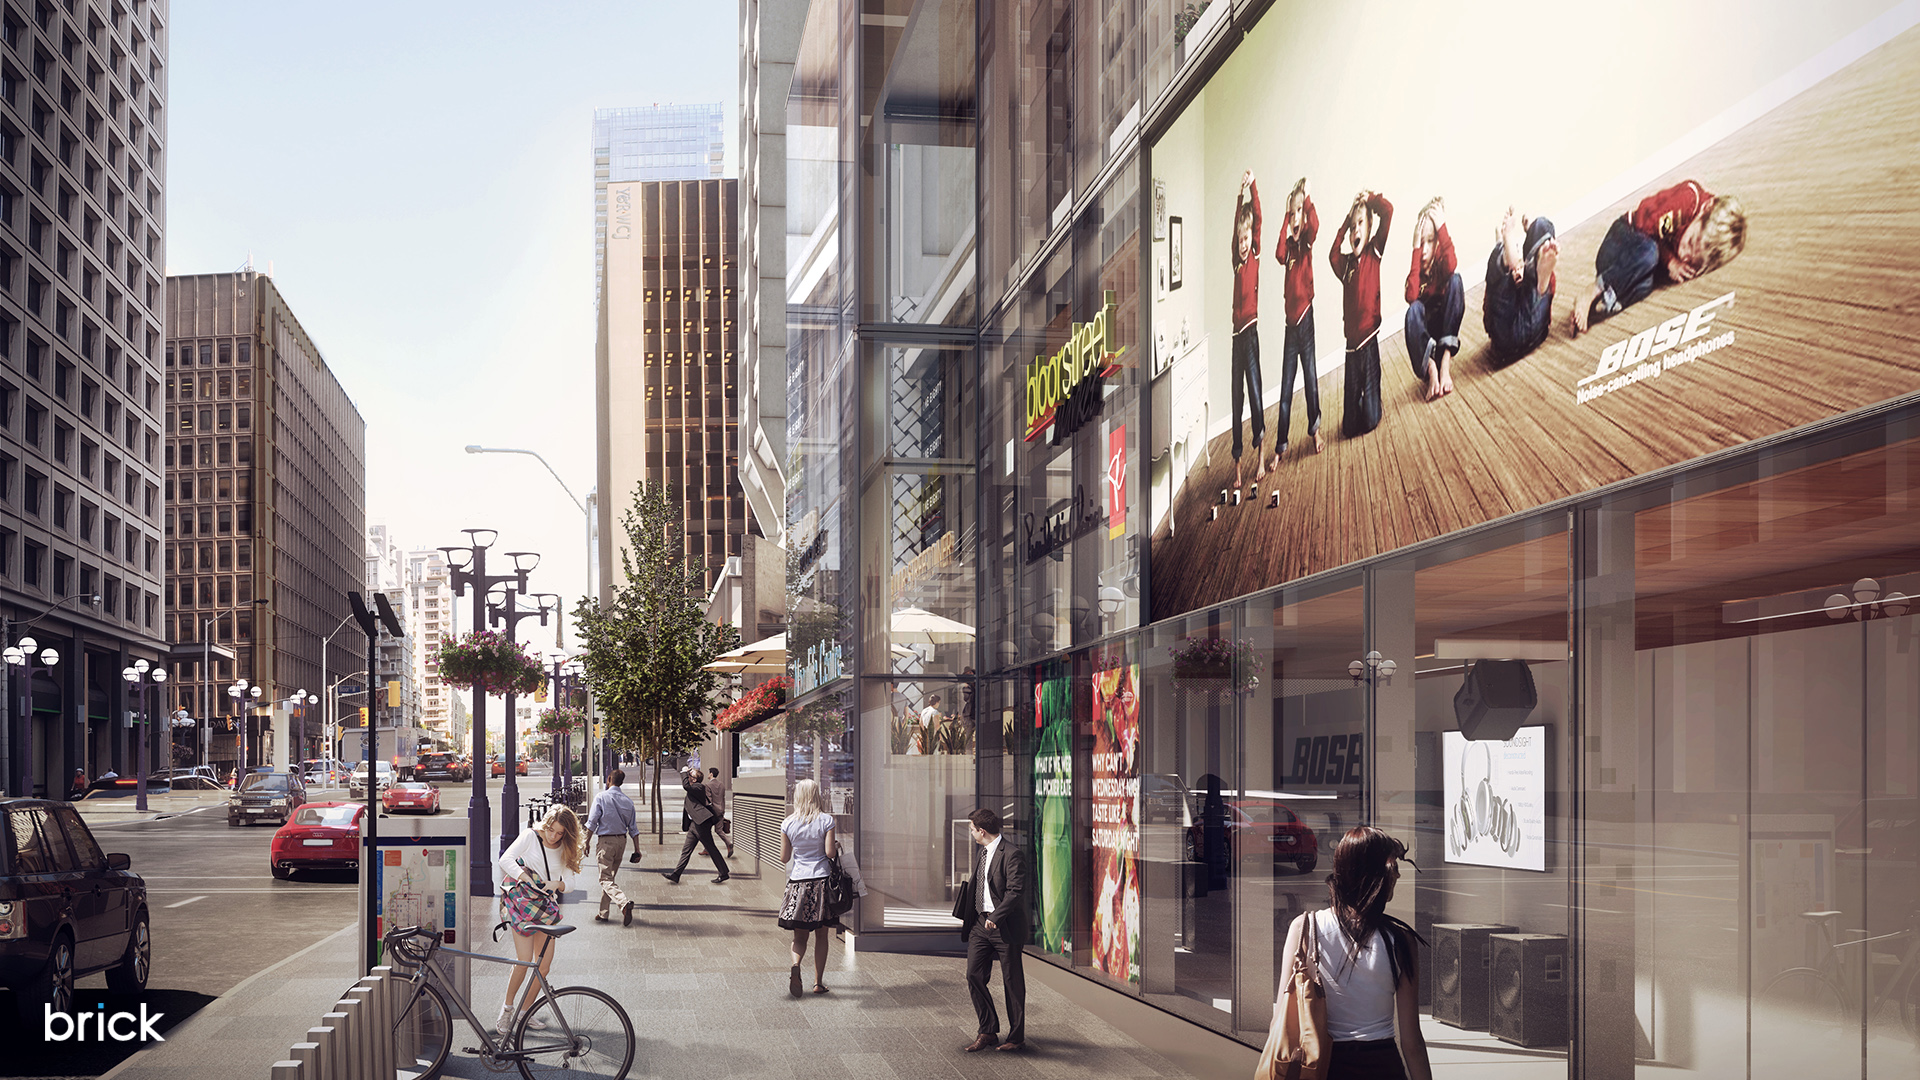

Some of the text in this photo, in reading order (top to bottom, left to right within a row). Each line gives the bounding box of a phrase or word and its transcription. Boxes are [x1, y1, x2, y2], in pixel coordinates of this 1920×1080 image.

[1577, 291, 1735, 387] BOSE
[1577, 331, 1735, 405] Noise-cancelling headphones
[1092, 752, 1123, 772] WHY CAN'T
[1281, 733, 1364, 785] BOSE
[1092, 778, 1125, 797] WEDNESDAY
[1092, 804, 1120, 823] TASTE LIKE
[1092, 828, 1138, 852] SATURDAY NIGHT
